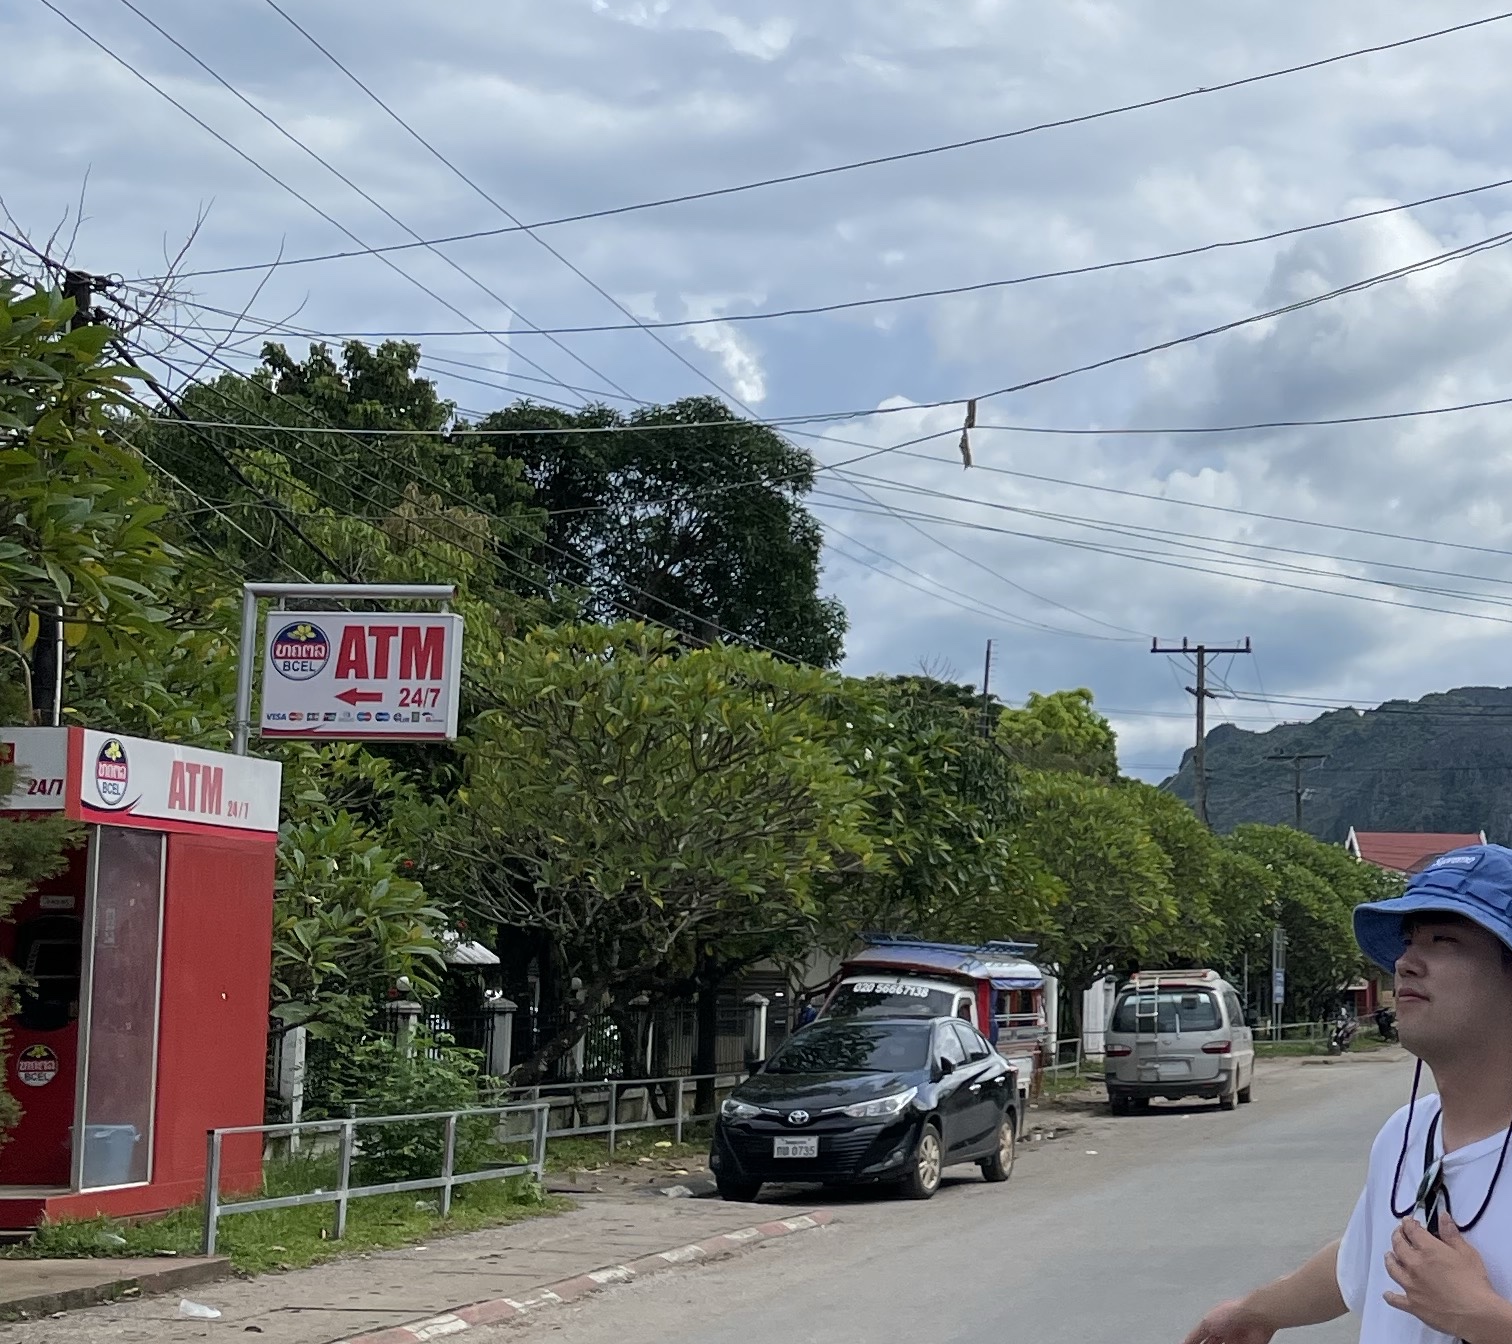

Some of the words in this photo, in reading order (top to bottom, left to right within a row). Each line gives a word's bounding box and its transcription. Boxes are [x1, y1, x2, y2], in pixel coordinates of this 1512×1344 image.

[334, 625, 445, 681] ATM
[282, 660, 317, 672] BCEL
[398, 687, 441, 708] 24/7
[266, 713, 287, 721] VISA
[27, 779, 64, 796] 24/7
[102, 781, 121, 796] BCEL
[167, 760, 224, 816] ATM
[227, 800, 249, 820] 24/7
[853, 982, 876, 993] 020
